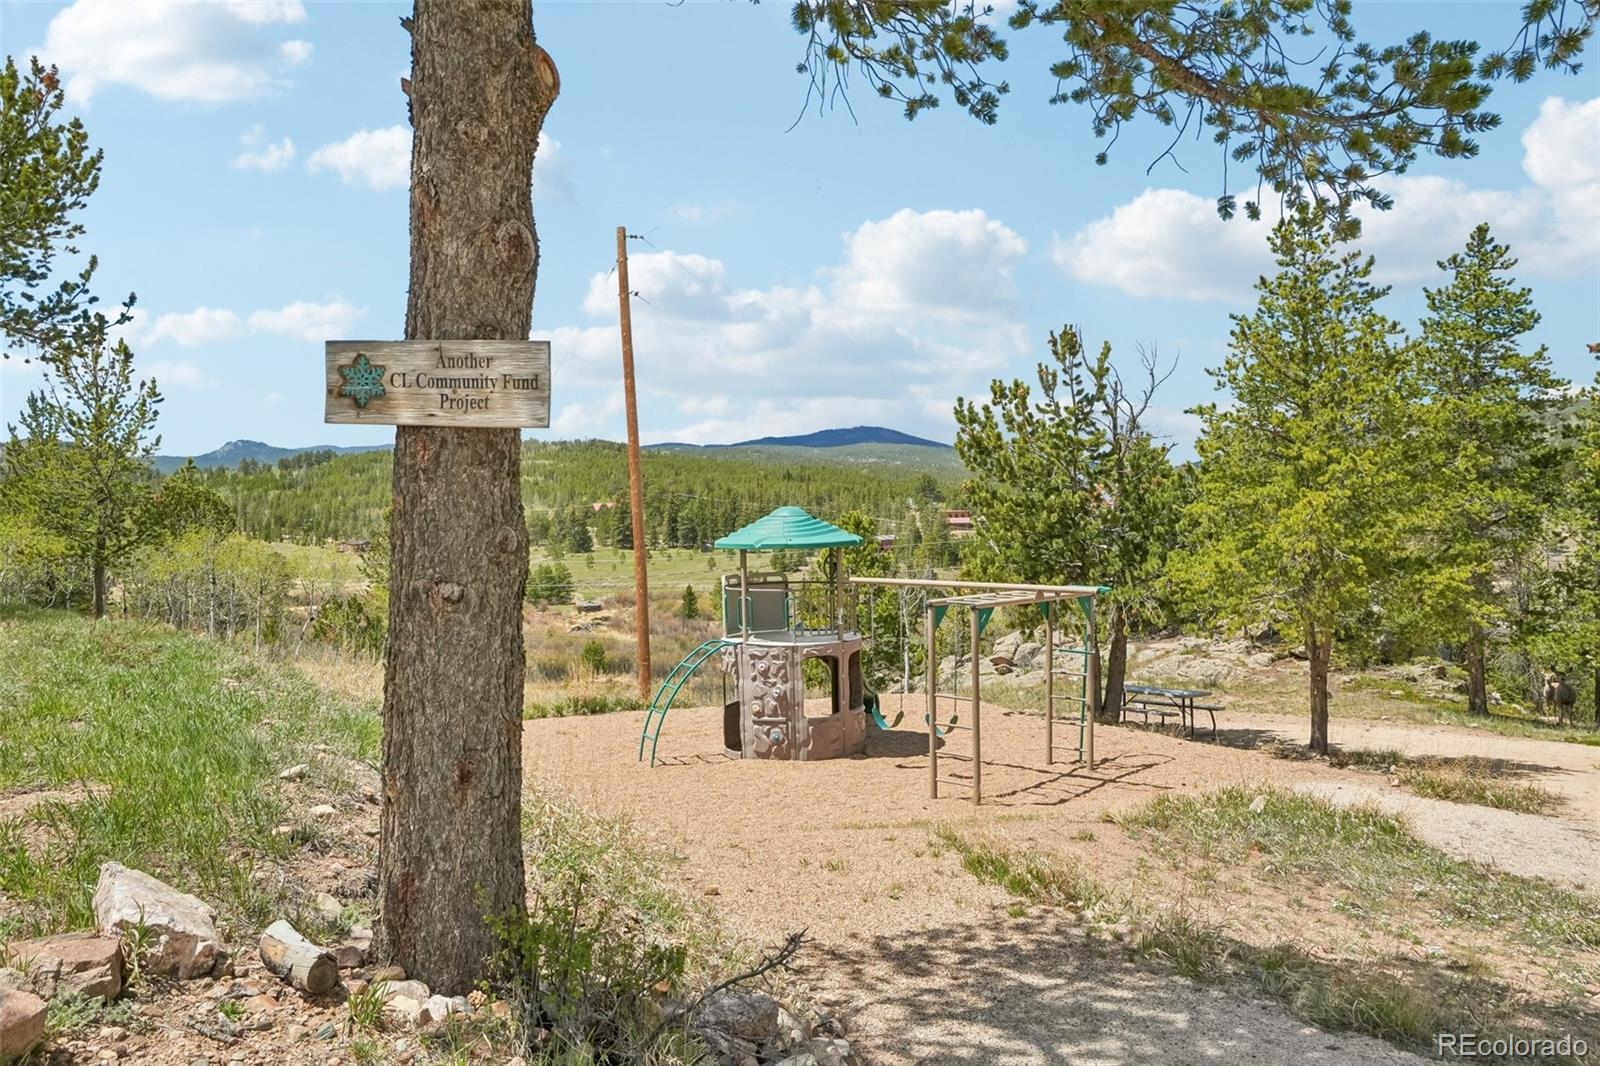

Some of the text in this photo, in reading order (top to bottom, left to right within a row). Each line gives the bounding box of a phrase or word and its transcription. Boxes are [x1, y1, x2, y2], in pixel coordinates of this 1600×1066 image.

[436, 351, 494, 369] Another
[390, 372, 539, 394] CL Community Fund
[439, 393, 490, 413] Project
